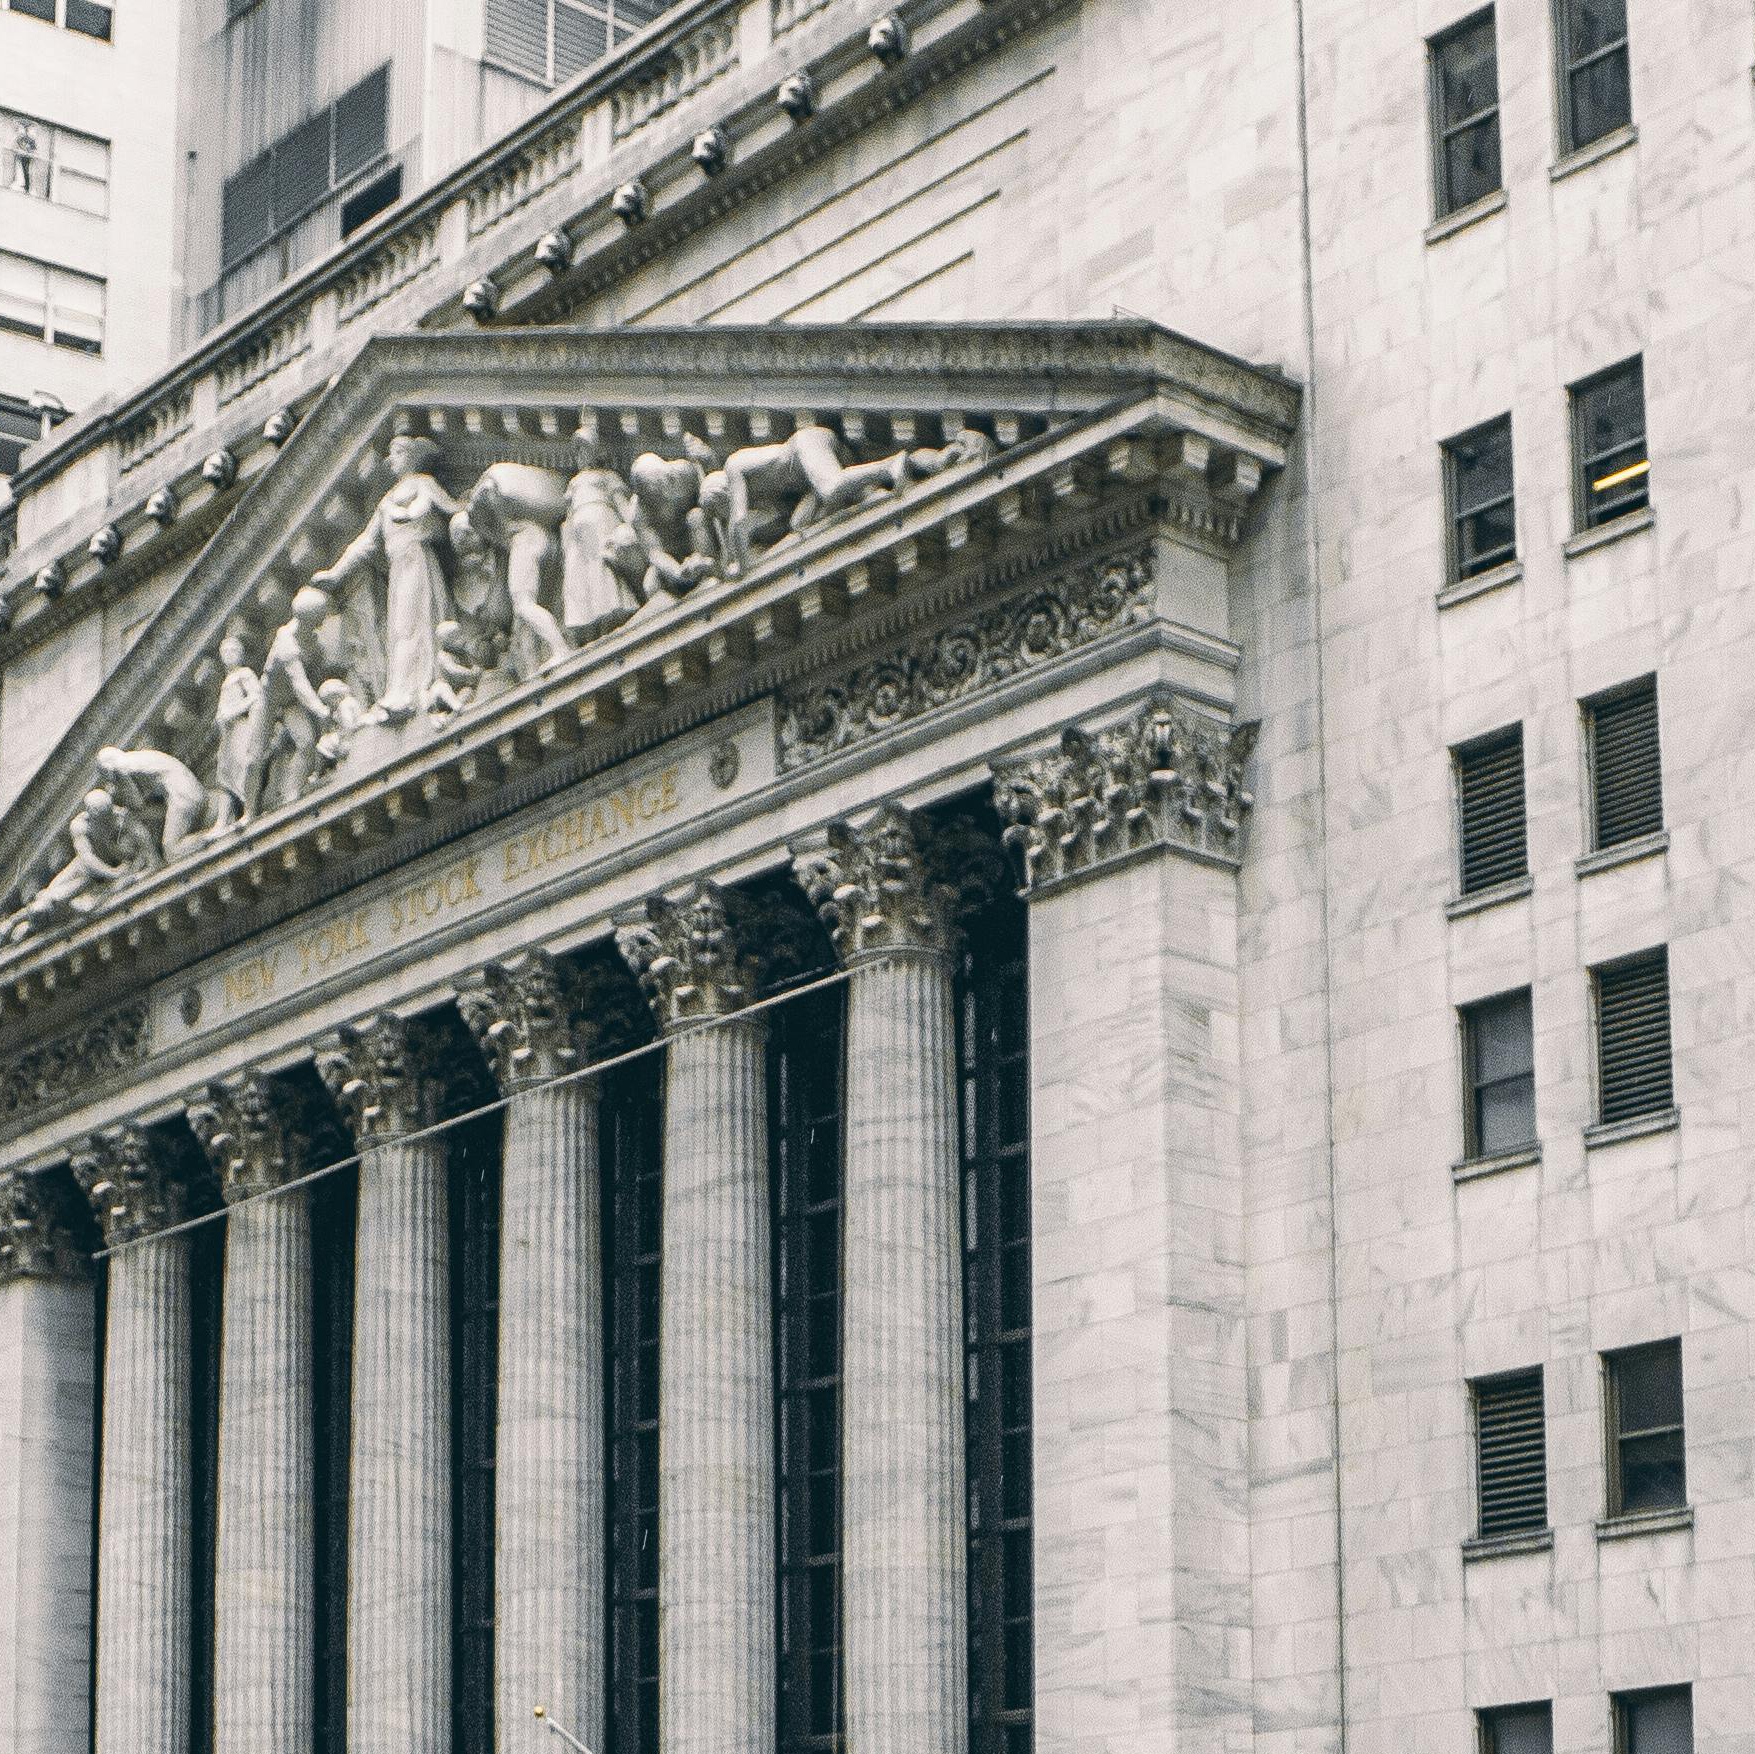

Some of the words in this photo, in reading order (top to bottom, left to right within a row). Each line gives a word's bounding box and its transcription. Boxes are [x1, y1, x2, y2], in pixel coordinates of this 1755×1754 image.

[224, 953, 280, 1008] NEW
[295, 912, 372, 984] YORK
[389, 855, 483, 938] STOCK
[503, 765, 680, 884] EXCHANGE
